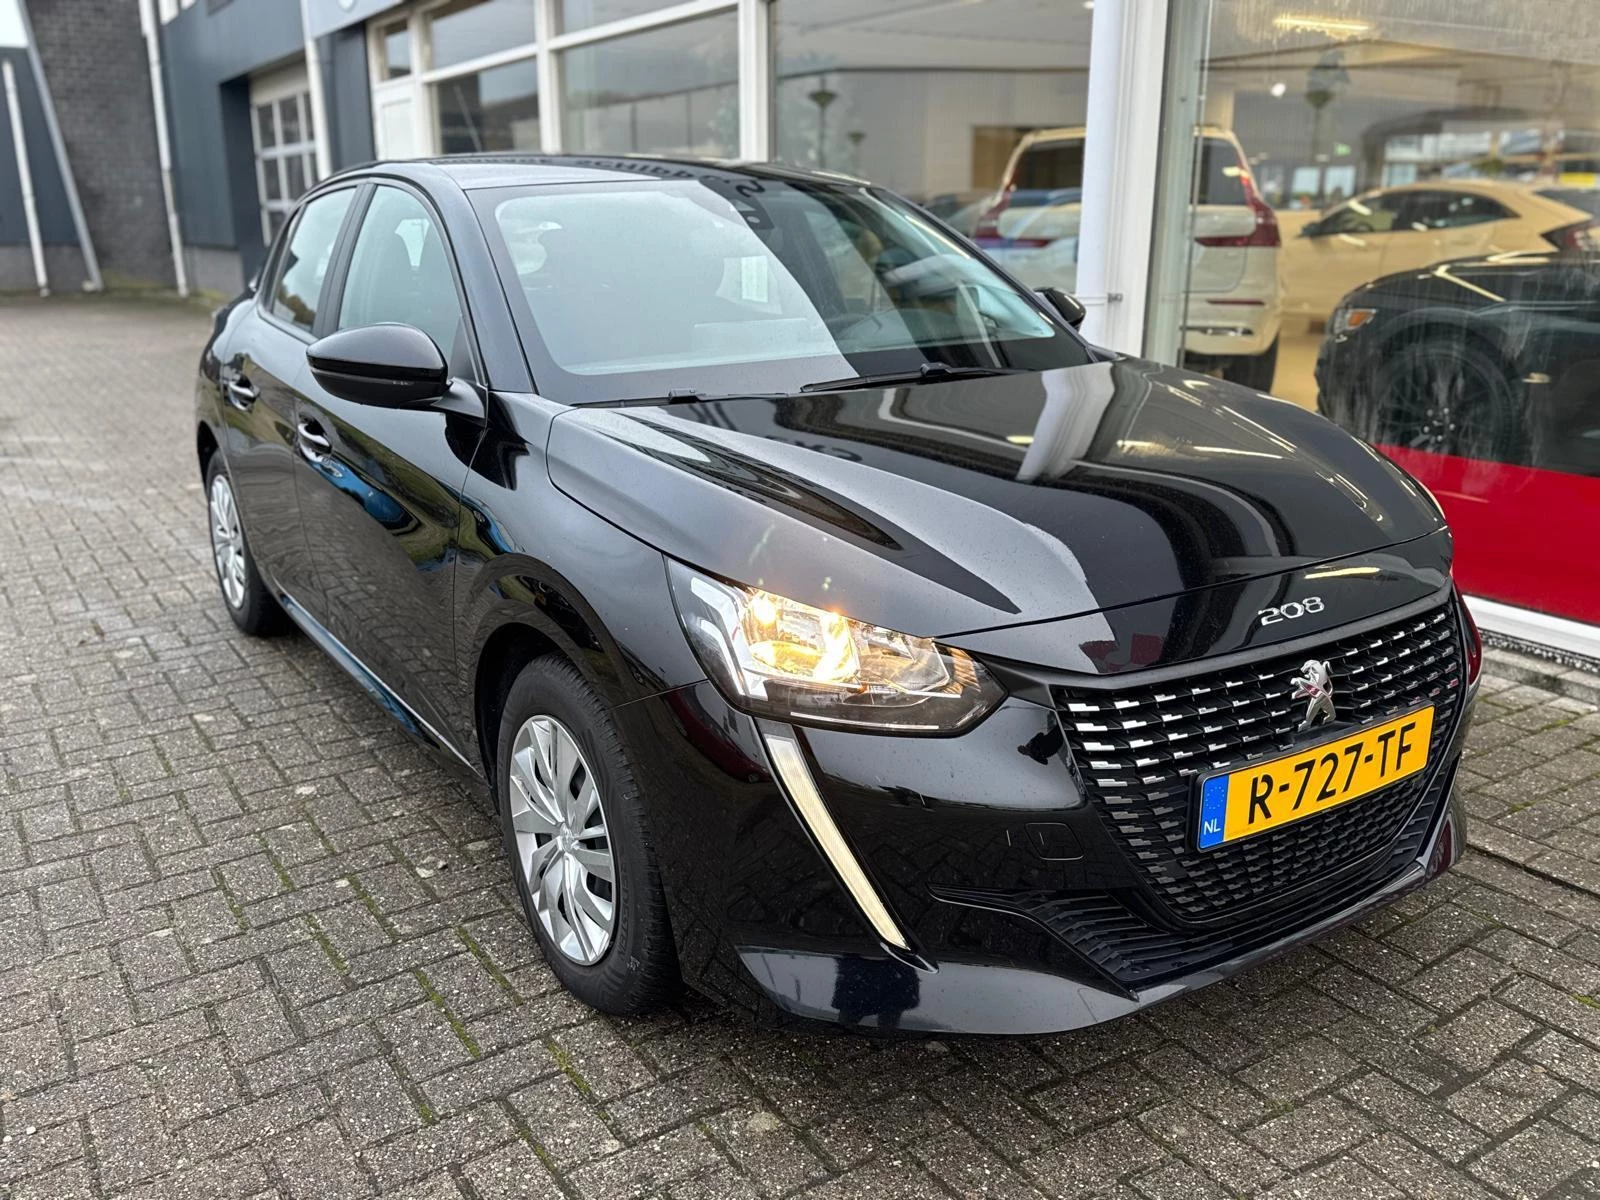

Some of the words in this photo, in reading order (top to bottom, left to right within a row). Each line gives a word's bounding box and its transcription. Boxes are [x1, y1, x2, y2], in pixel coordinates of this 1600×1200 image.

[1258, 597, 1325, 625] 208
[1248, 723, 1416, 824] R-727-TF
[1203, 818, 1221, 835] NL
